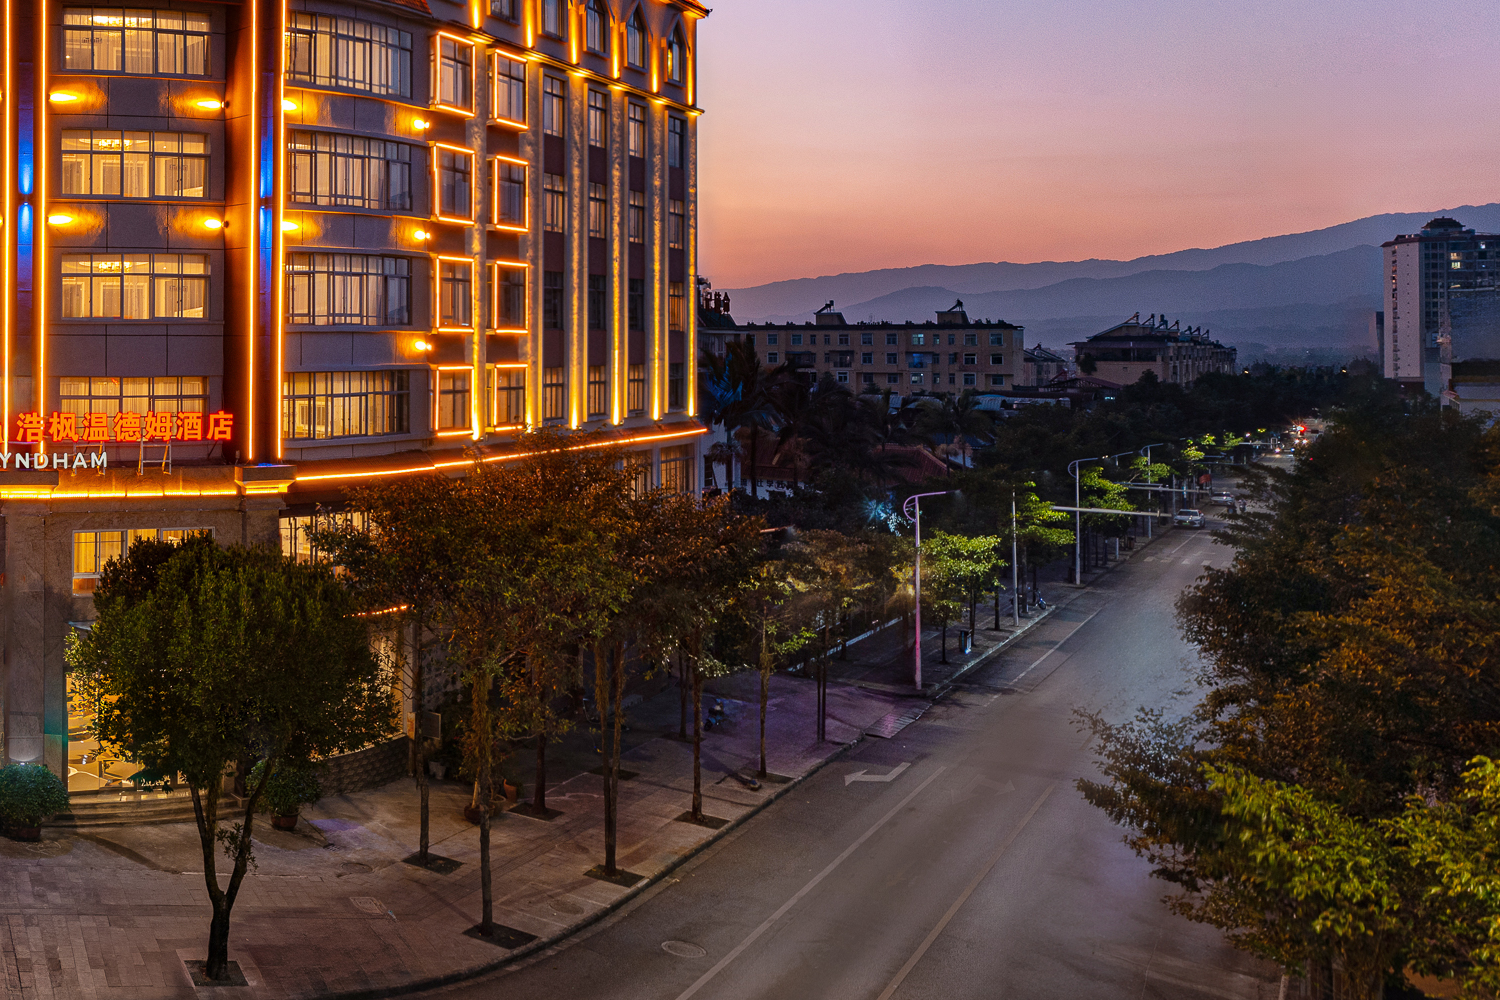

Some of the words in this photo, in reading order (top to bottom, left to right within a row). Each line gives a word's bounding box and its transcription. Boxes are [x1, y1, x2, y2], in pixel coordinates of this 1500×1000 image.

[16, 411, 233, 442] 浩枫温德姆酒店
